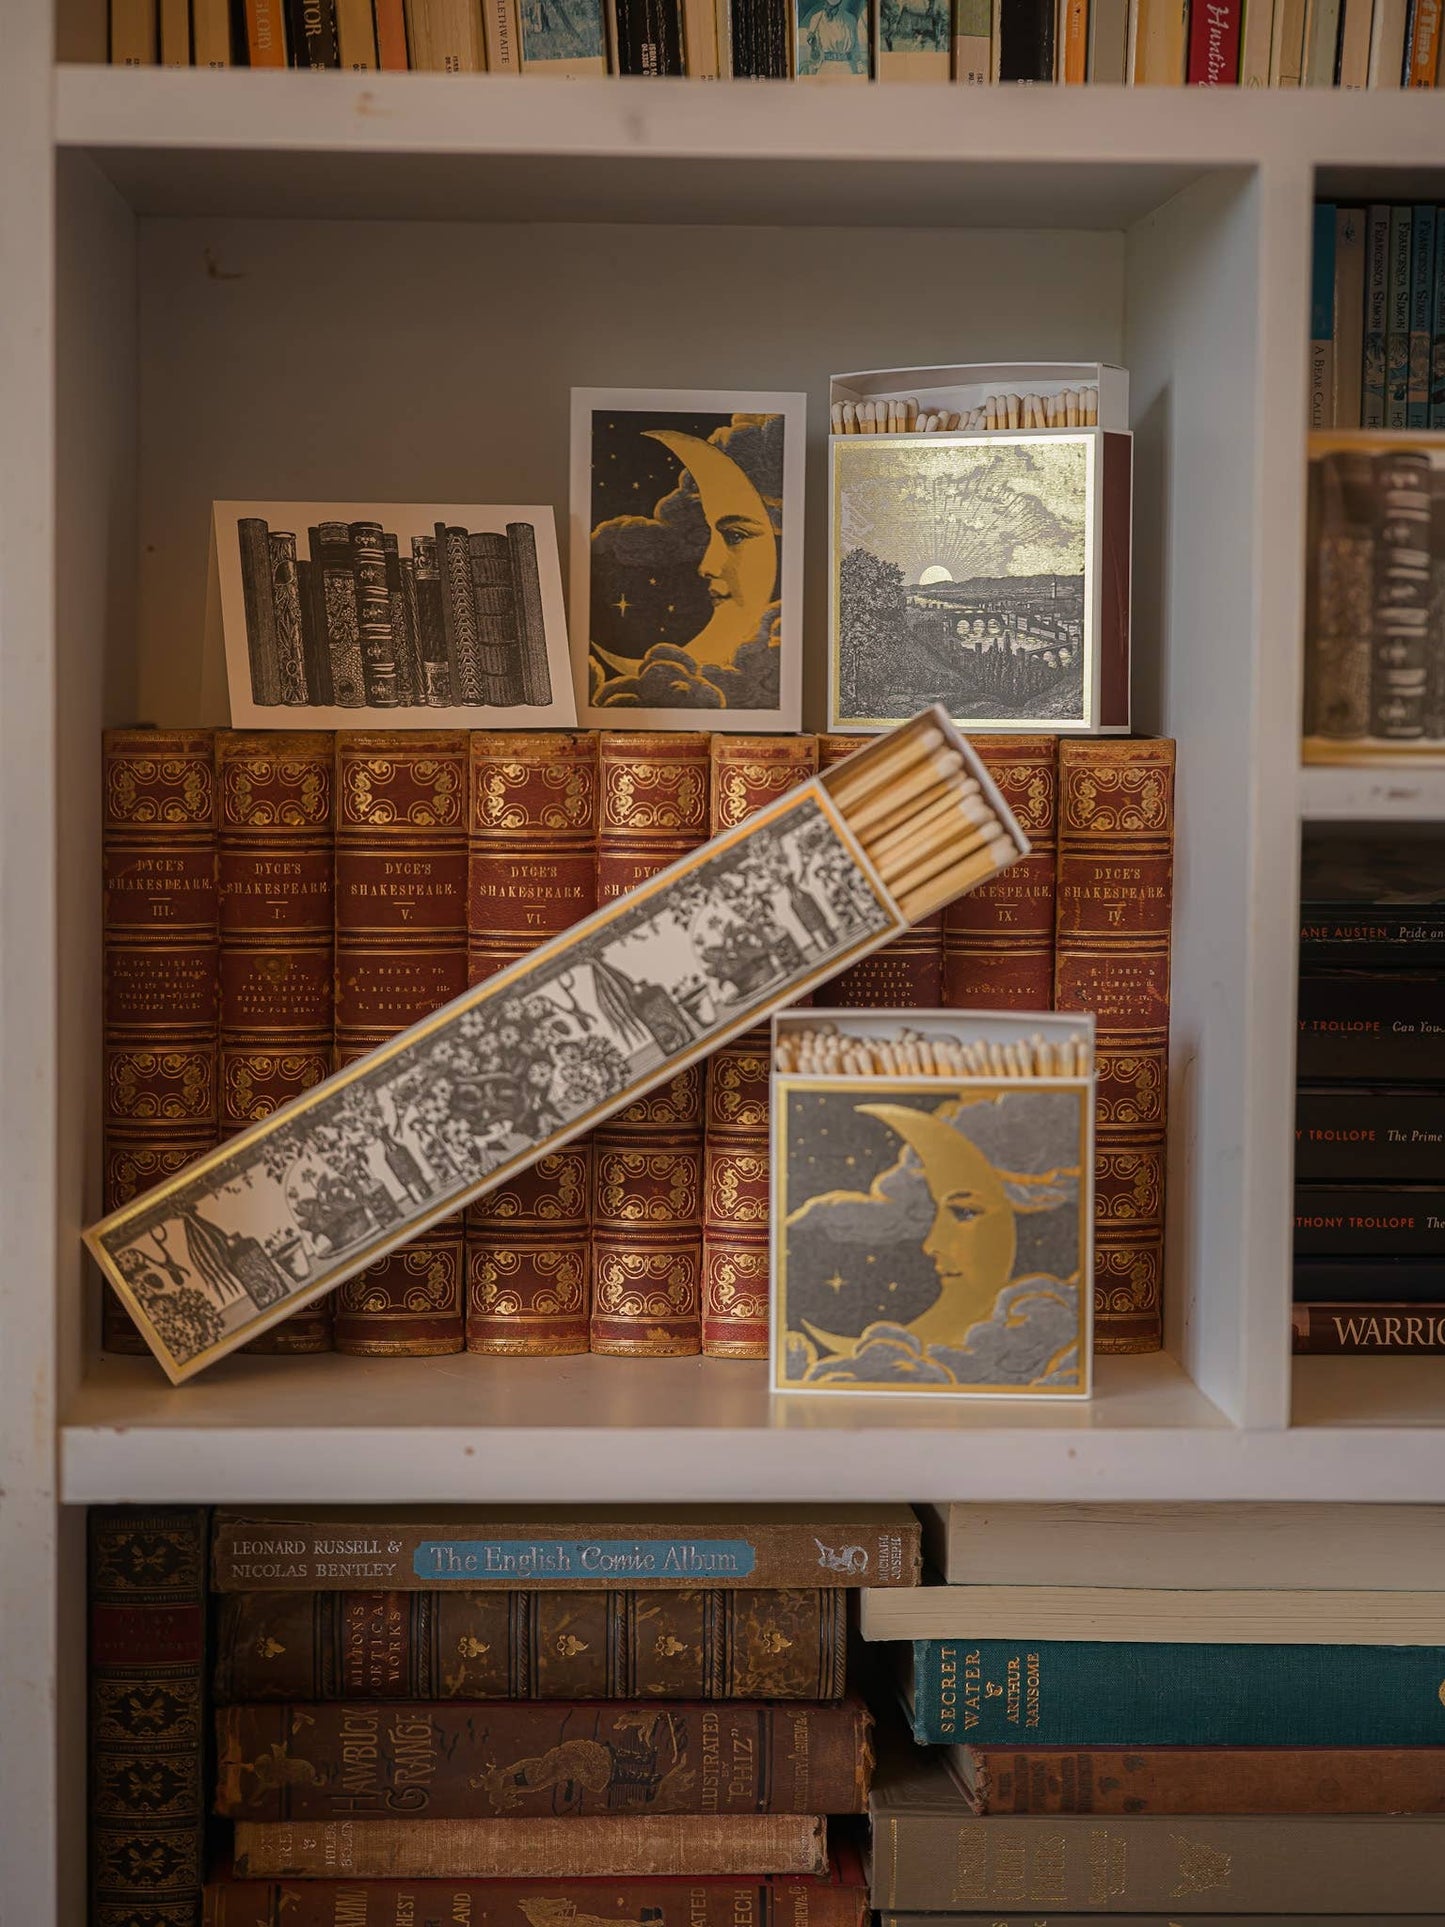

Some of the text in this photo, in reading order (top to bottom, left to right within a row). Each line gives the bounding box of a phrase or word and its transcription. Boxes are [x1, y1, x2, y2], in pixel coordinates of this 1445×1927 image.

[1372, 291, 1385, 329] SIMON
[1395, 291, 1408, 329] SIMON
[1415, 290, 1429, 328] SIMON
[255, 863, 301, 875] DYCE'S
[385, 863, 431, 874] DYCE'S
[511, 866, 558, 878] DYCE'S
[1095, 868, 1141, 880] DYCE'S
[1334, 927, 1387, 938] AUSTEN
[1399, 926, 1427, 939] Pride
[1430, 929, 1445, 939] an
[1312, 1021, 1381, 1032] TROLLOPE
[1392, 1021, 1415, 1033] Can
[1309, 1129, 1376, 1142] TROLLOPE
[1387, 1129, 1408, 1142] The
[1411, 1129, 1443, 1142] Prime
[1348, 1217, 1415, 1228] TROLLOPE
[232, 1540, 402, 1556] LEONARD RUSSELL &
[430, 1545, 738, 1577] The English Comic Album
[232, 1563, 397, 1578] NICOLAS BENTLEY
[388, 1611, 401, 1682] WORKS
[941, 1647, 956, 1733] SECRET
[965, 1650, 980, 1730] WATER
[1007, 1656, 1020, 1725] ARTHUR
[1026, 1652, 1039, 1728] RANSOME
